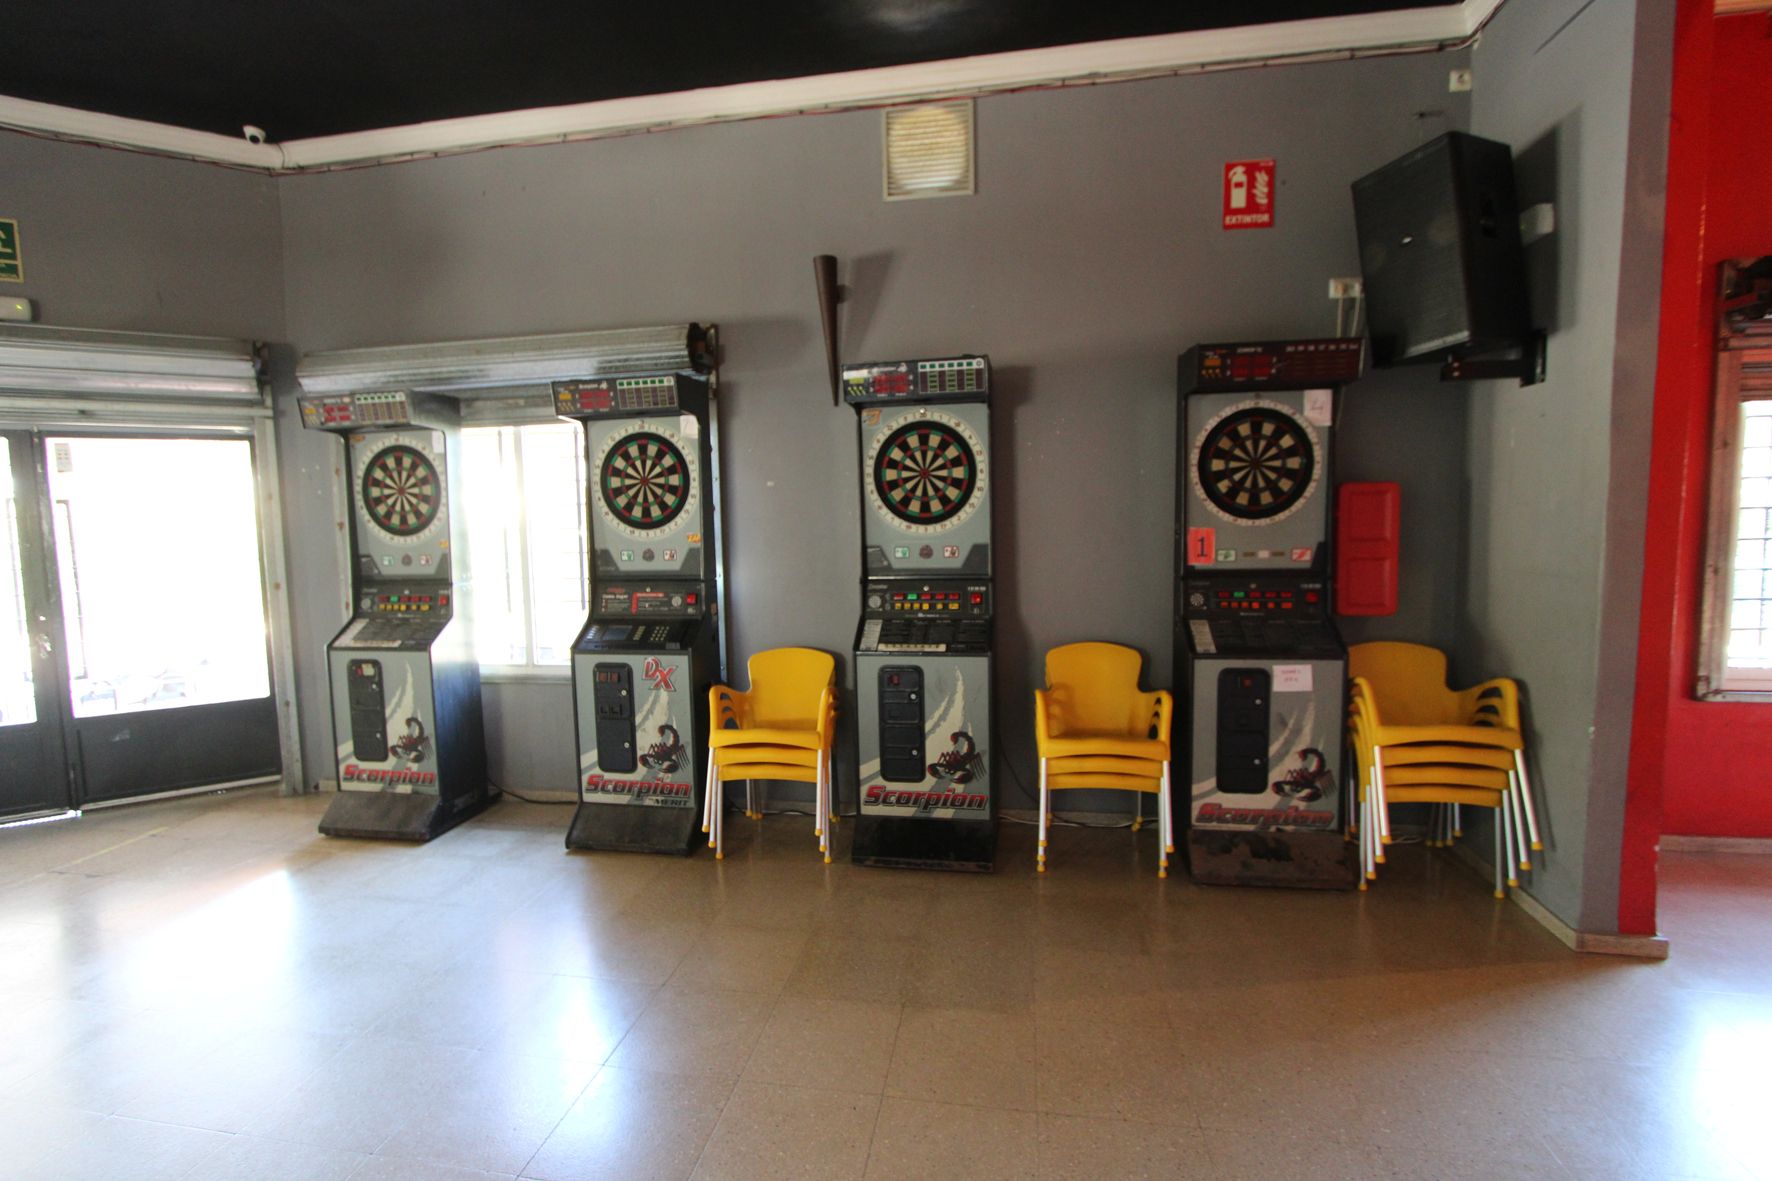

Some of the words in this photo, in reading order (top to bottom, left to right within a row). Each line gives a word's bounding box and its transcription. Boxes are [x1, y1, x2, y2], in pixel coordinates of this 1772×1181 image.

[1224, 213, 1270, 226] EXTINTOR
[1196, 536, 1208, 558] 1
[642, 656, 679, 692] DX
[343, 763, 436, 786] Scorpion
[585, 774, 692, 799] Scorpion
[863, 785, 988, 813] Scorpion
[1195, 803, 1335, 827] Scorpion
